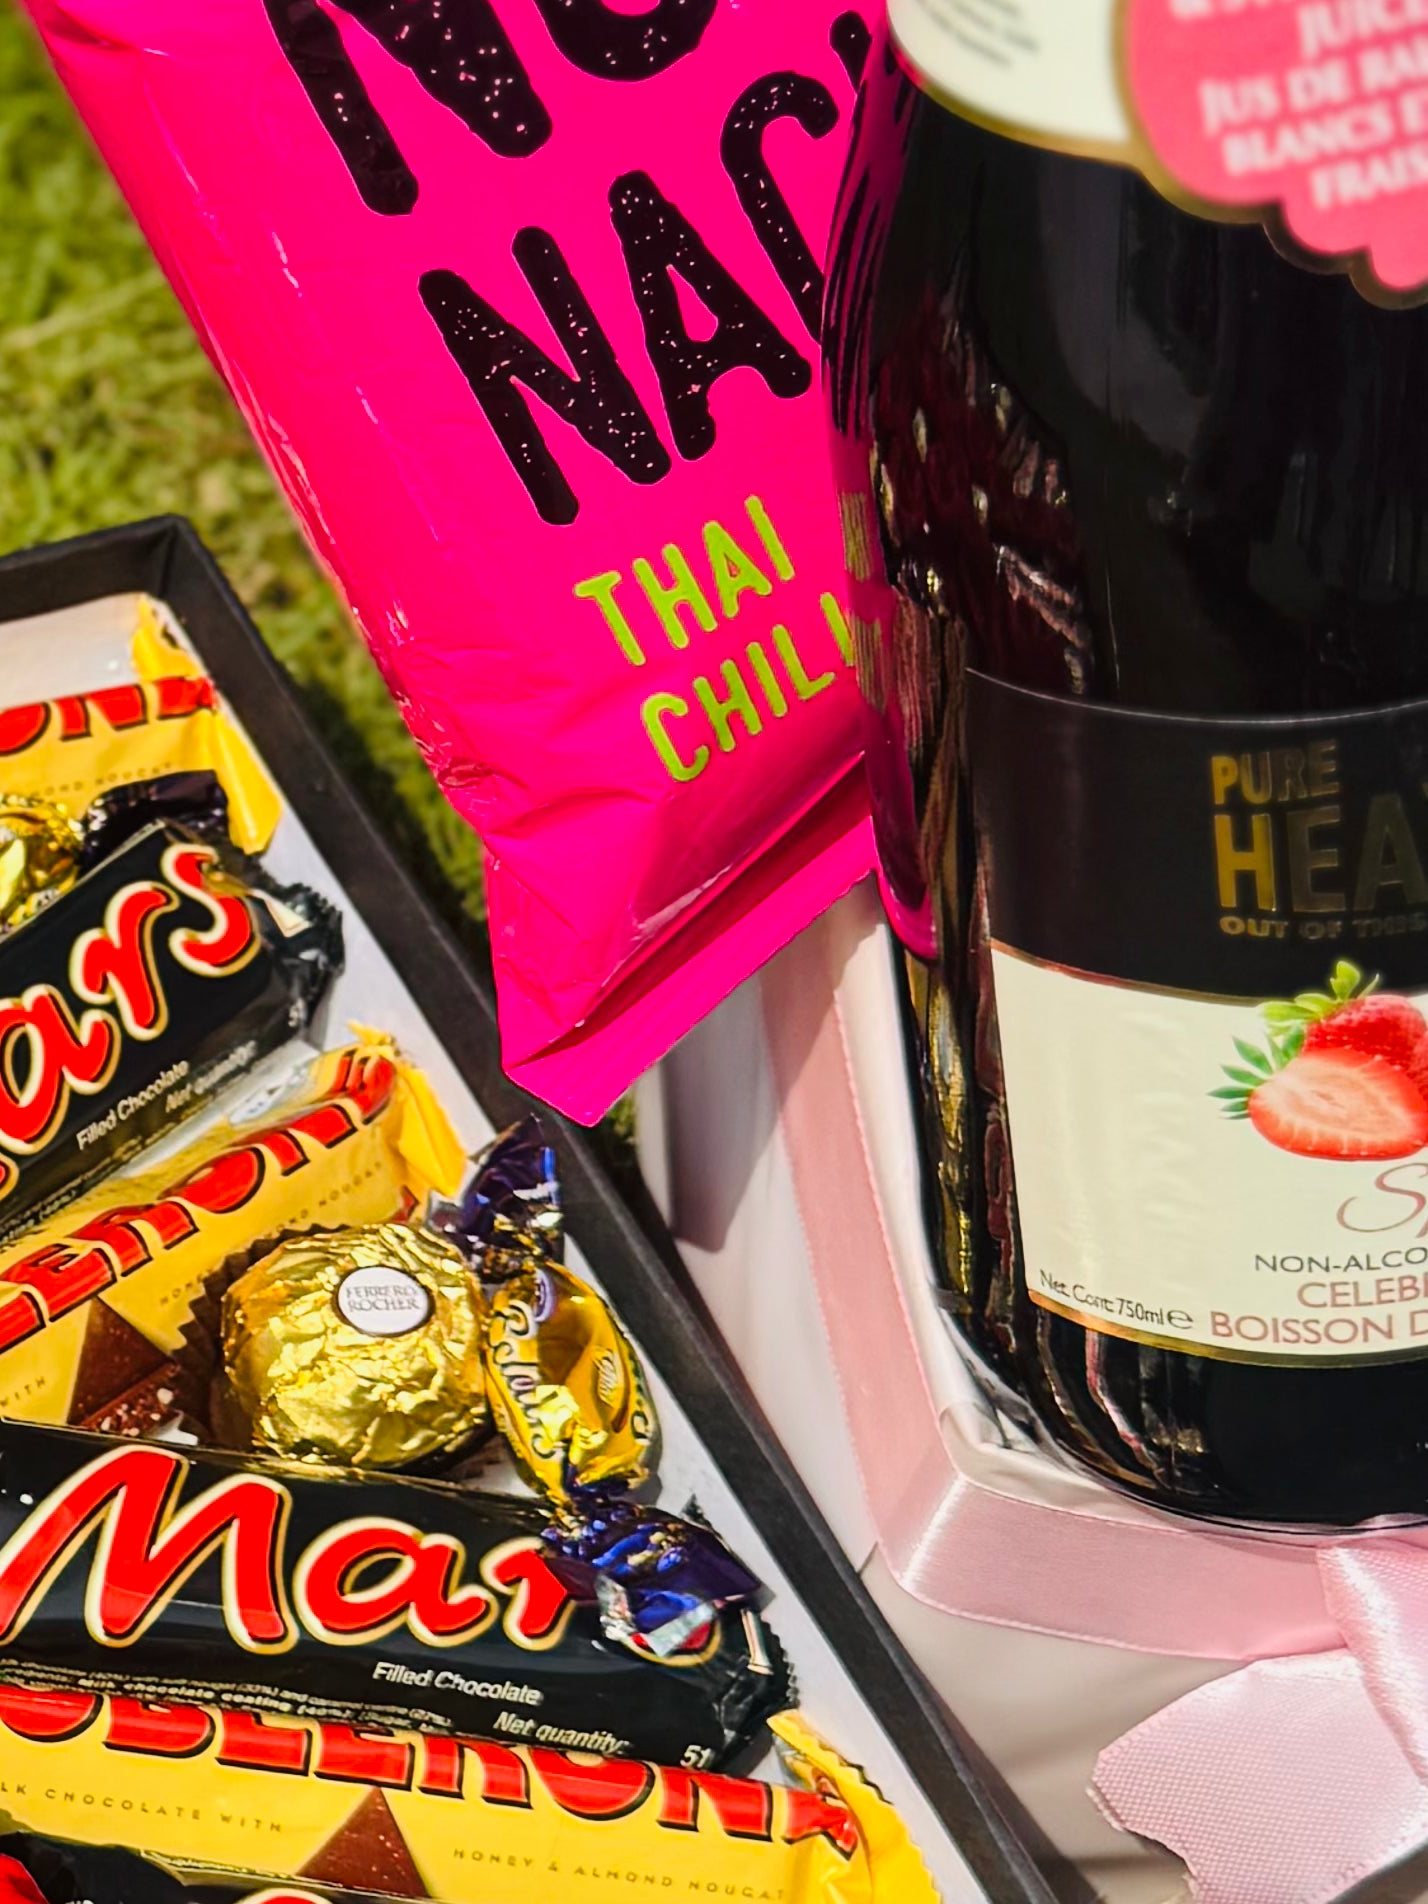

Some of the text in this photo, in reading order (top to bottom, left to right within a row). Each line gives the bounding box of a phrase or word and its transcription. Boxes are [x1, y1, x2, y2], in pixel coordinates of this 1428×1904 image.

[1286, 57, 1349, 112] DE
[417, 10, 871, 526] NAC
[574, 494, 795, 667] THAI
[1211, 739, 1340, 806] PURE
[1214, 782, 1428, 913] HEA
[1219, 914, 1289, 939] OUT
[1300, 918, 1343, 940] OF
[77, 1059, 191, 1151] Filled Chocolate
[1255, 1246, 1428, 1274] NON-ALCO
[346, 1283, 417, 1299] FERRERO
[347, 1297, 421, 1313] ROCHER
[1297, 1271, 1428, 1309] CELEB
[1210, 1310, 1394, 1345] BOISSON
[373, 1660, 543, 1707] Filled Chocolate
[493, 1710, 534, 1737] Net
[44, 1787, 202, 1822] CHOCOLATE
[219, 1812, 283, 1833] WITH
[452, 1847, 535, 1869] HONEY
[548, 1860, 560, 1872] &
[574, 1864, 673, 1889] ALMOND
